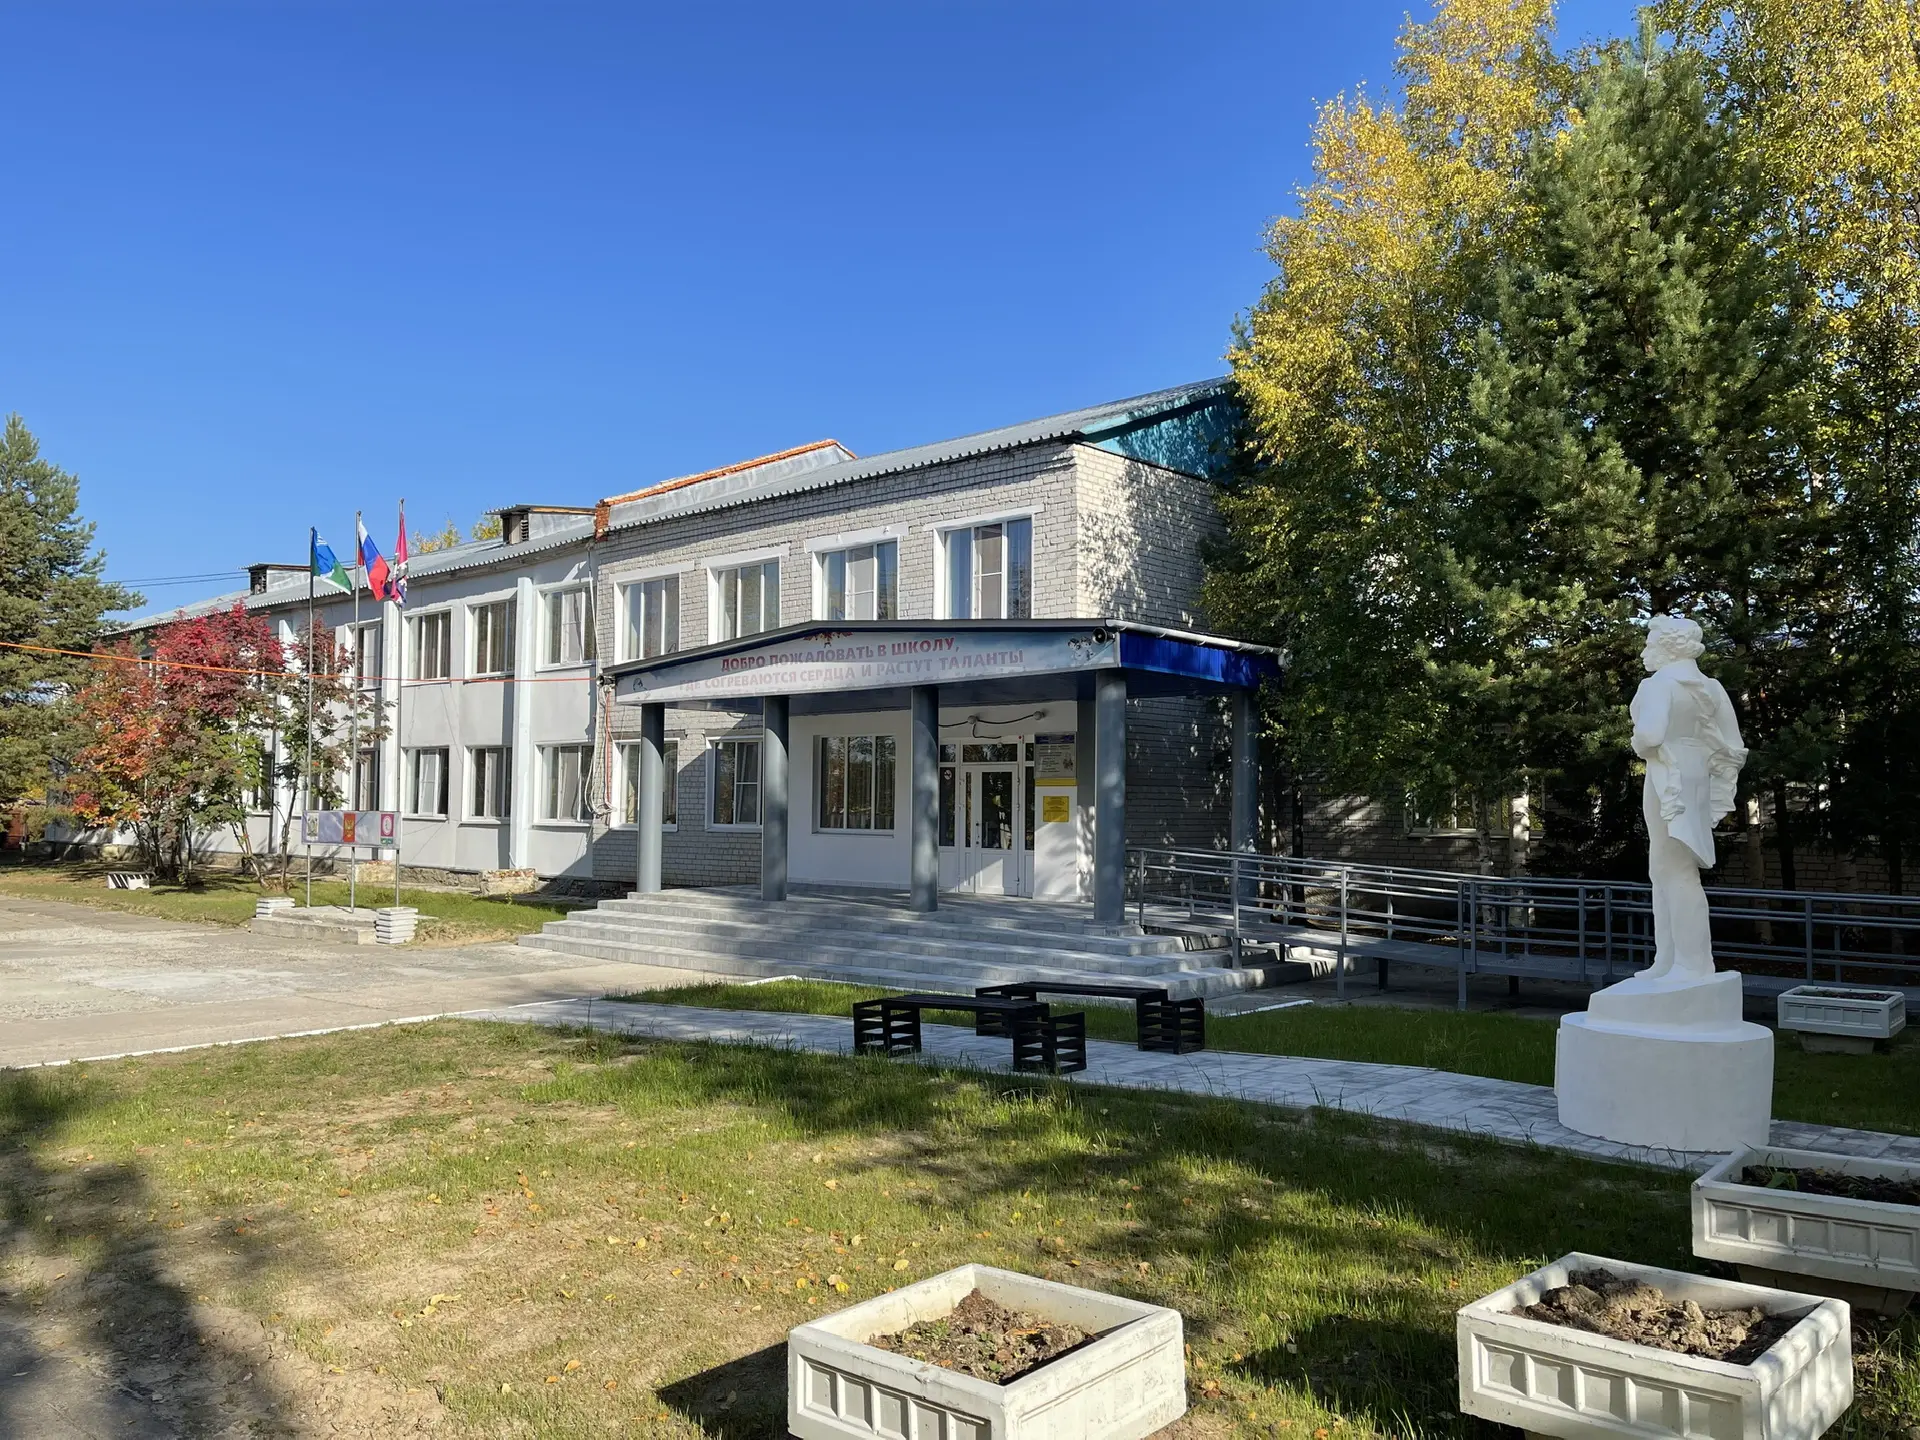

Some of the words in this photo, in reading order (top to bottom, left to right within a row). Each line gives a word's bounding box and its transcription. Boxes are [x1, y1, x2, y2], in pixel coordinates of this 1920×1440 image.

[704, 671, 797, 689] СОГРЕВАЮТСЯ
[800, 667, 856, 682] СЕРДЦА
[861, 664, 872, 677] И
[876, 659, 933, 676] РАСТУТ
[939, 650, 1024, 671] ТАЛАНТЫ
[721, 655, 766, 672] ДОБРО
[769, 645, 874, 665] ПОЖАЛОВАТЬ
[877, 644, 887, 657] В
[891, 637, 960, 656] ШКОЛУ,
